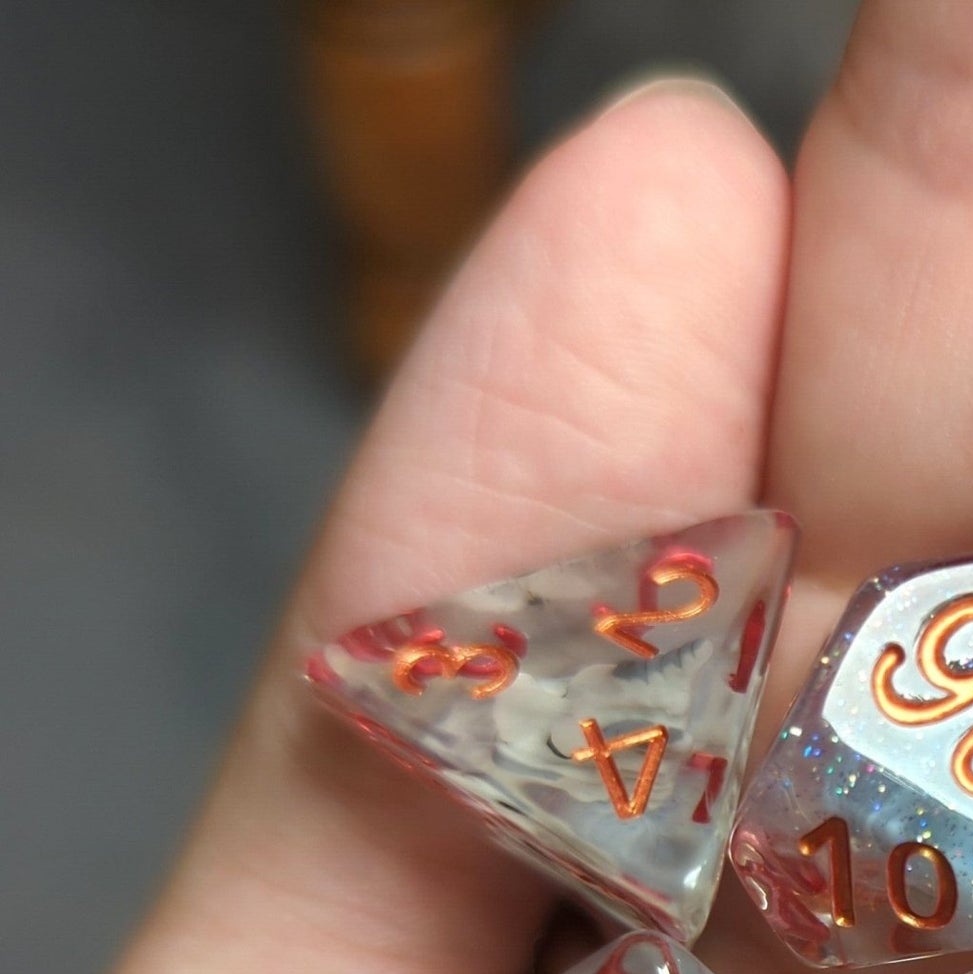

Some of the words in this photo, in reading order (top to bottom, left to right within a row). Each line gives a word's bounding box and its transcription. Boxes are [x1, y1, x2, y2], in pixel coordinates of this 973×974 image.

[595, 562, 720, 658] 2
[572, 717, 669, 820] 4
[799, 816, 957, 931] 10
